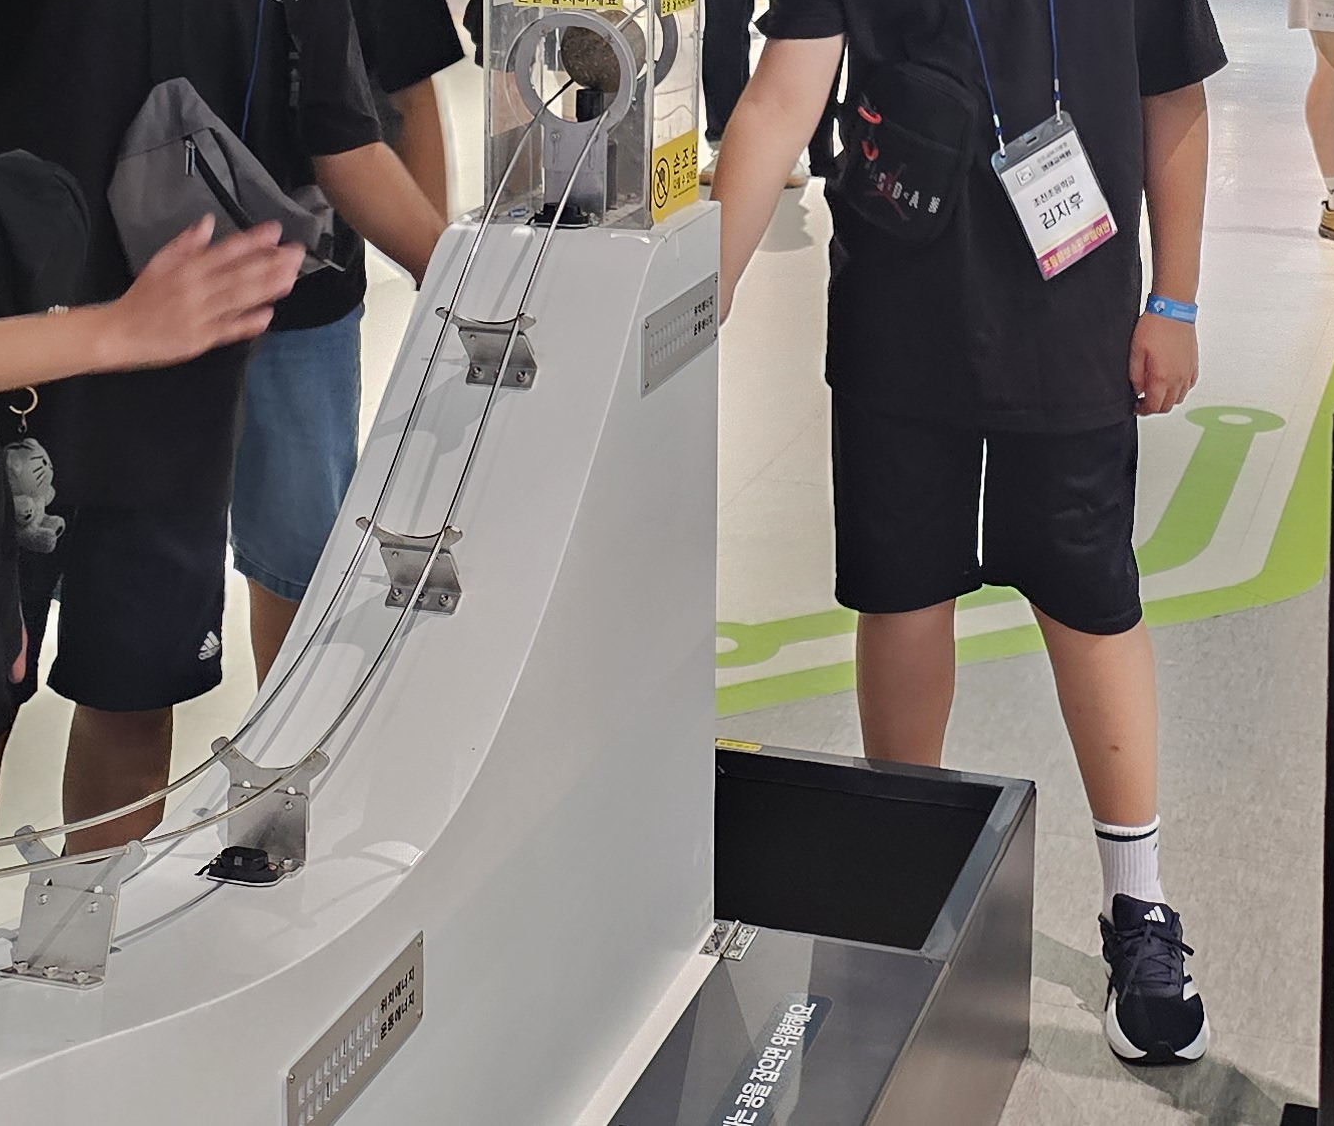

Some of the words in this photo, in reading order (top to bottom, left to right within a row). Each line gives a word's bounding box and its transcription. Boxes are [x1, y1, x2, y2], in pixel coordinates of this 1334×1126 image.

[1039, 191, 1084, 230] 김지후
[380, 965, 415, 1014] 위치에너지
[380, 989, 415, 1041] 운동에너지
[770, 1002, 818, 1047] 위험해요
[748, 1046, 793, 1083] 잡으면
[734, 1082, 773, 1109] 공을
[722, 1109, 758, 1126] 는
